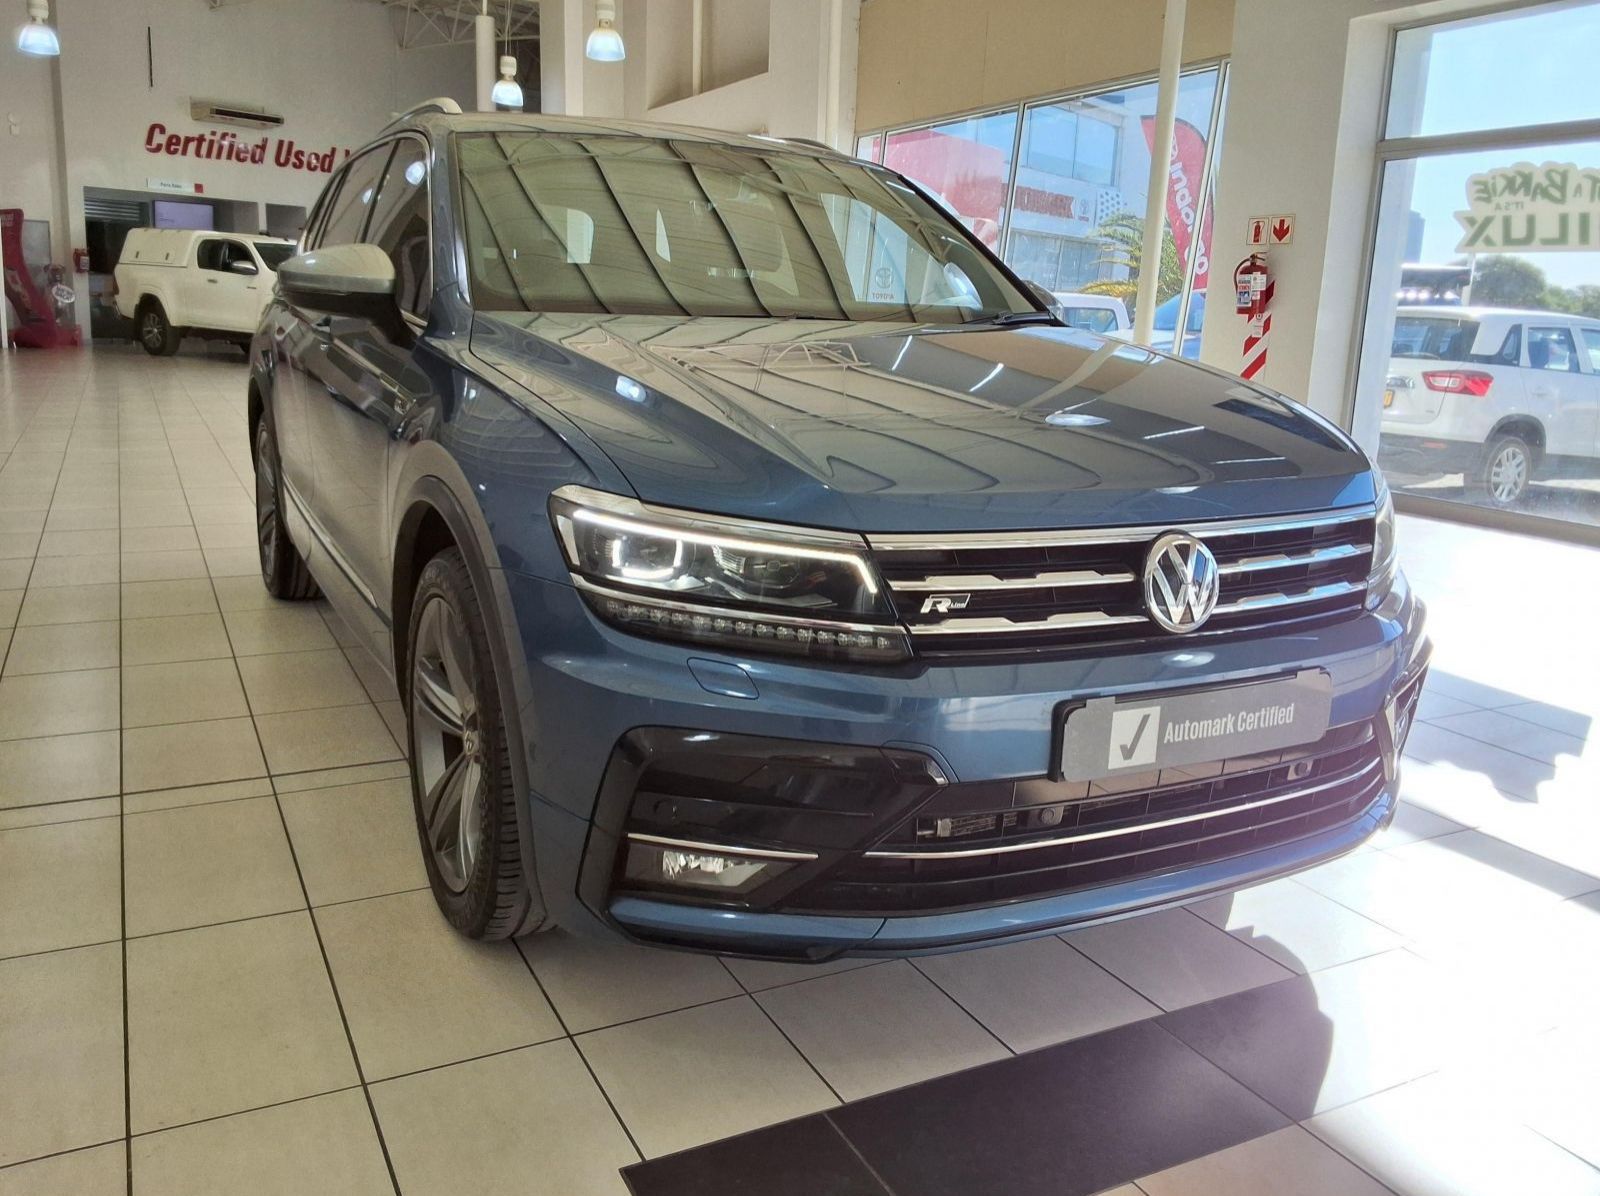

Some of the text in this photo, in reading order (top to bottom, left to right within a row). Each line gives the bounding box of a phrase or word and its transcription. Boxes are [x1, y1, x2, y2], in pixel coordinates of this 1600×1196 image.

[145, 123, 337, 173] Certified Used
[1163, 703, 1295, 744] Automark Certified
